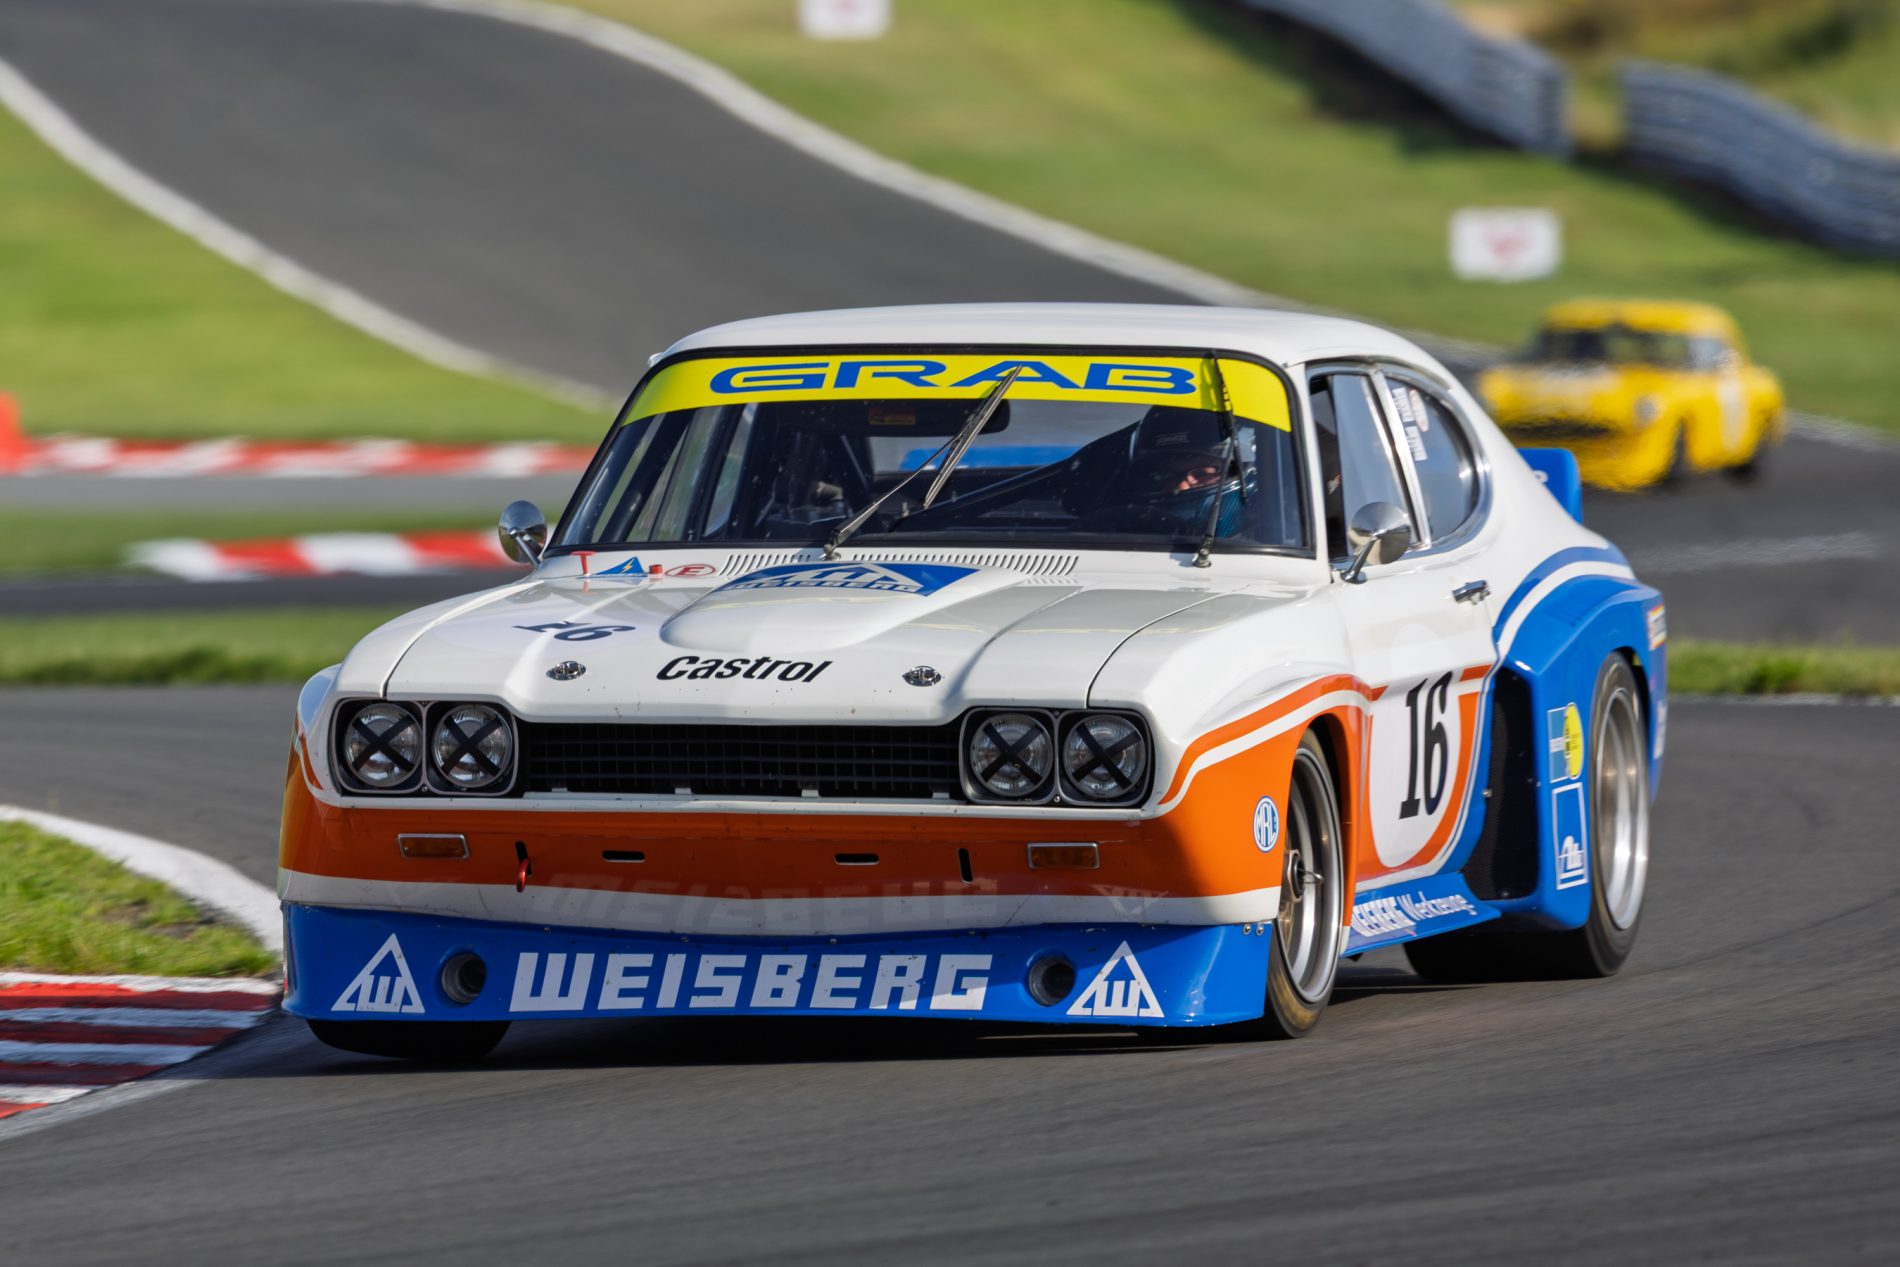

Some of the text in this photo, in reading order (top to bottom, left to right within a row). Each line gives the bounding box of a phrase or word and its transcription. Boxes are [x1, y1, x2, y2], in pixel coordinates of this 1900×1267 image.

[709, 360, 1197, 394] GRAB
[512, 620, 636, 641] 16
[656, 655, 833, 683] Castrol
[1398, 670, 1453, 819] 16
[508, 952, 993, 1012] WEISBERG
